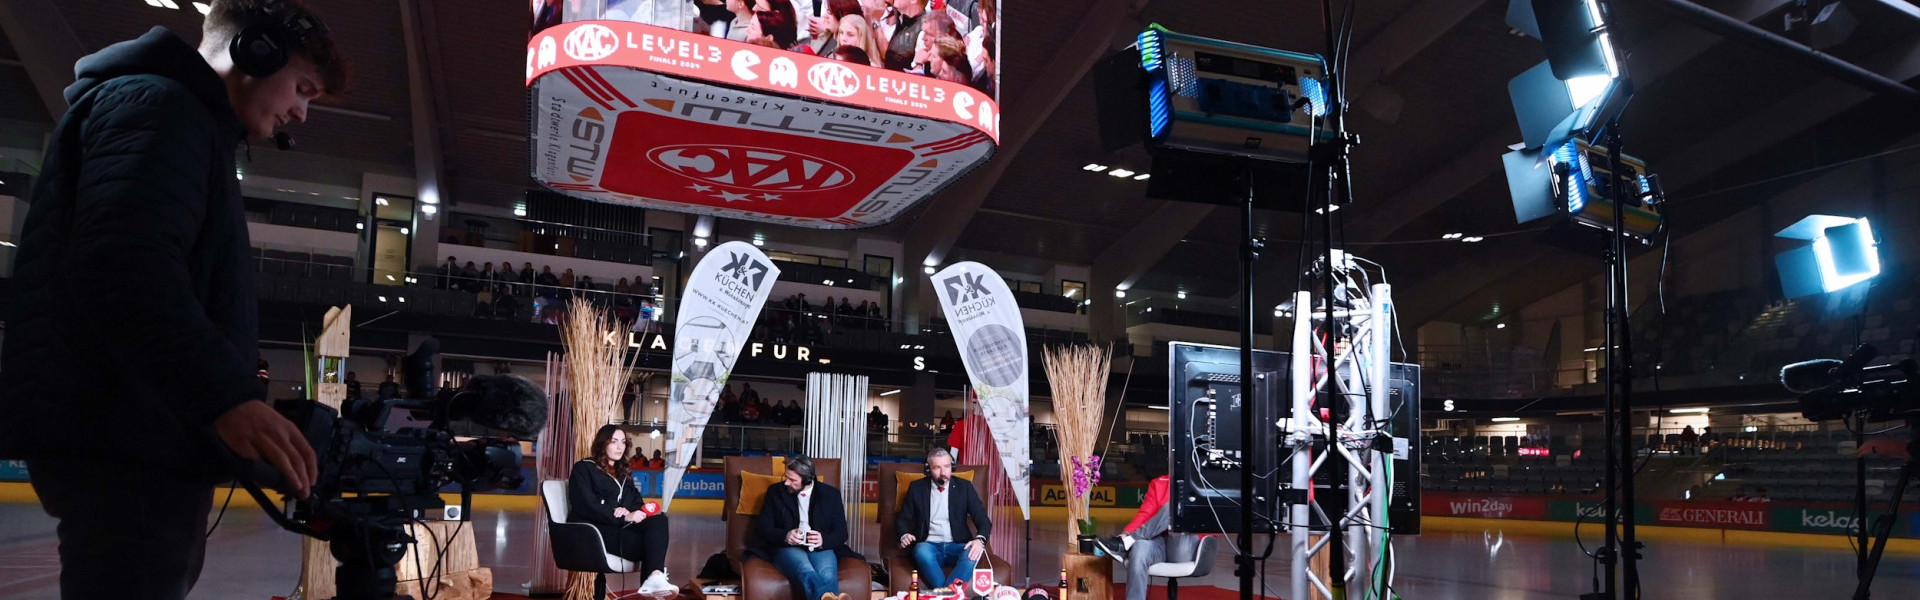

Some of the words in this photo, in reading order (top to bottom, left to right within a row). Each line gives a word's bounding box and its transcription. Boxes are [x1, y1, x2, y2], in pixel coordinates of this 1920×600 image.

[566, 25, 615, 60] KAC
[626, 31, 722, 63] LEVEL3
[650, 80, 785, 111] Klagenfurt
[811, 62, 857, 96] KAC
[866, 74, 946, 103] LEVEL3
[680, 102, 887, 143] STW
[801, 107, 928, 132] Stadtwerke
[566, 118, 605, 177] STW
[676, 146, 842, 192] KAC
[714, 271, 755, 303] KÜCHEN
[1044, 488, 1113, 503] ADRAL
[1449, 499, 1513, 516] win2day
[1682, 508, 1765, 526] GENERALI
